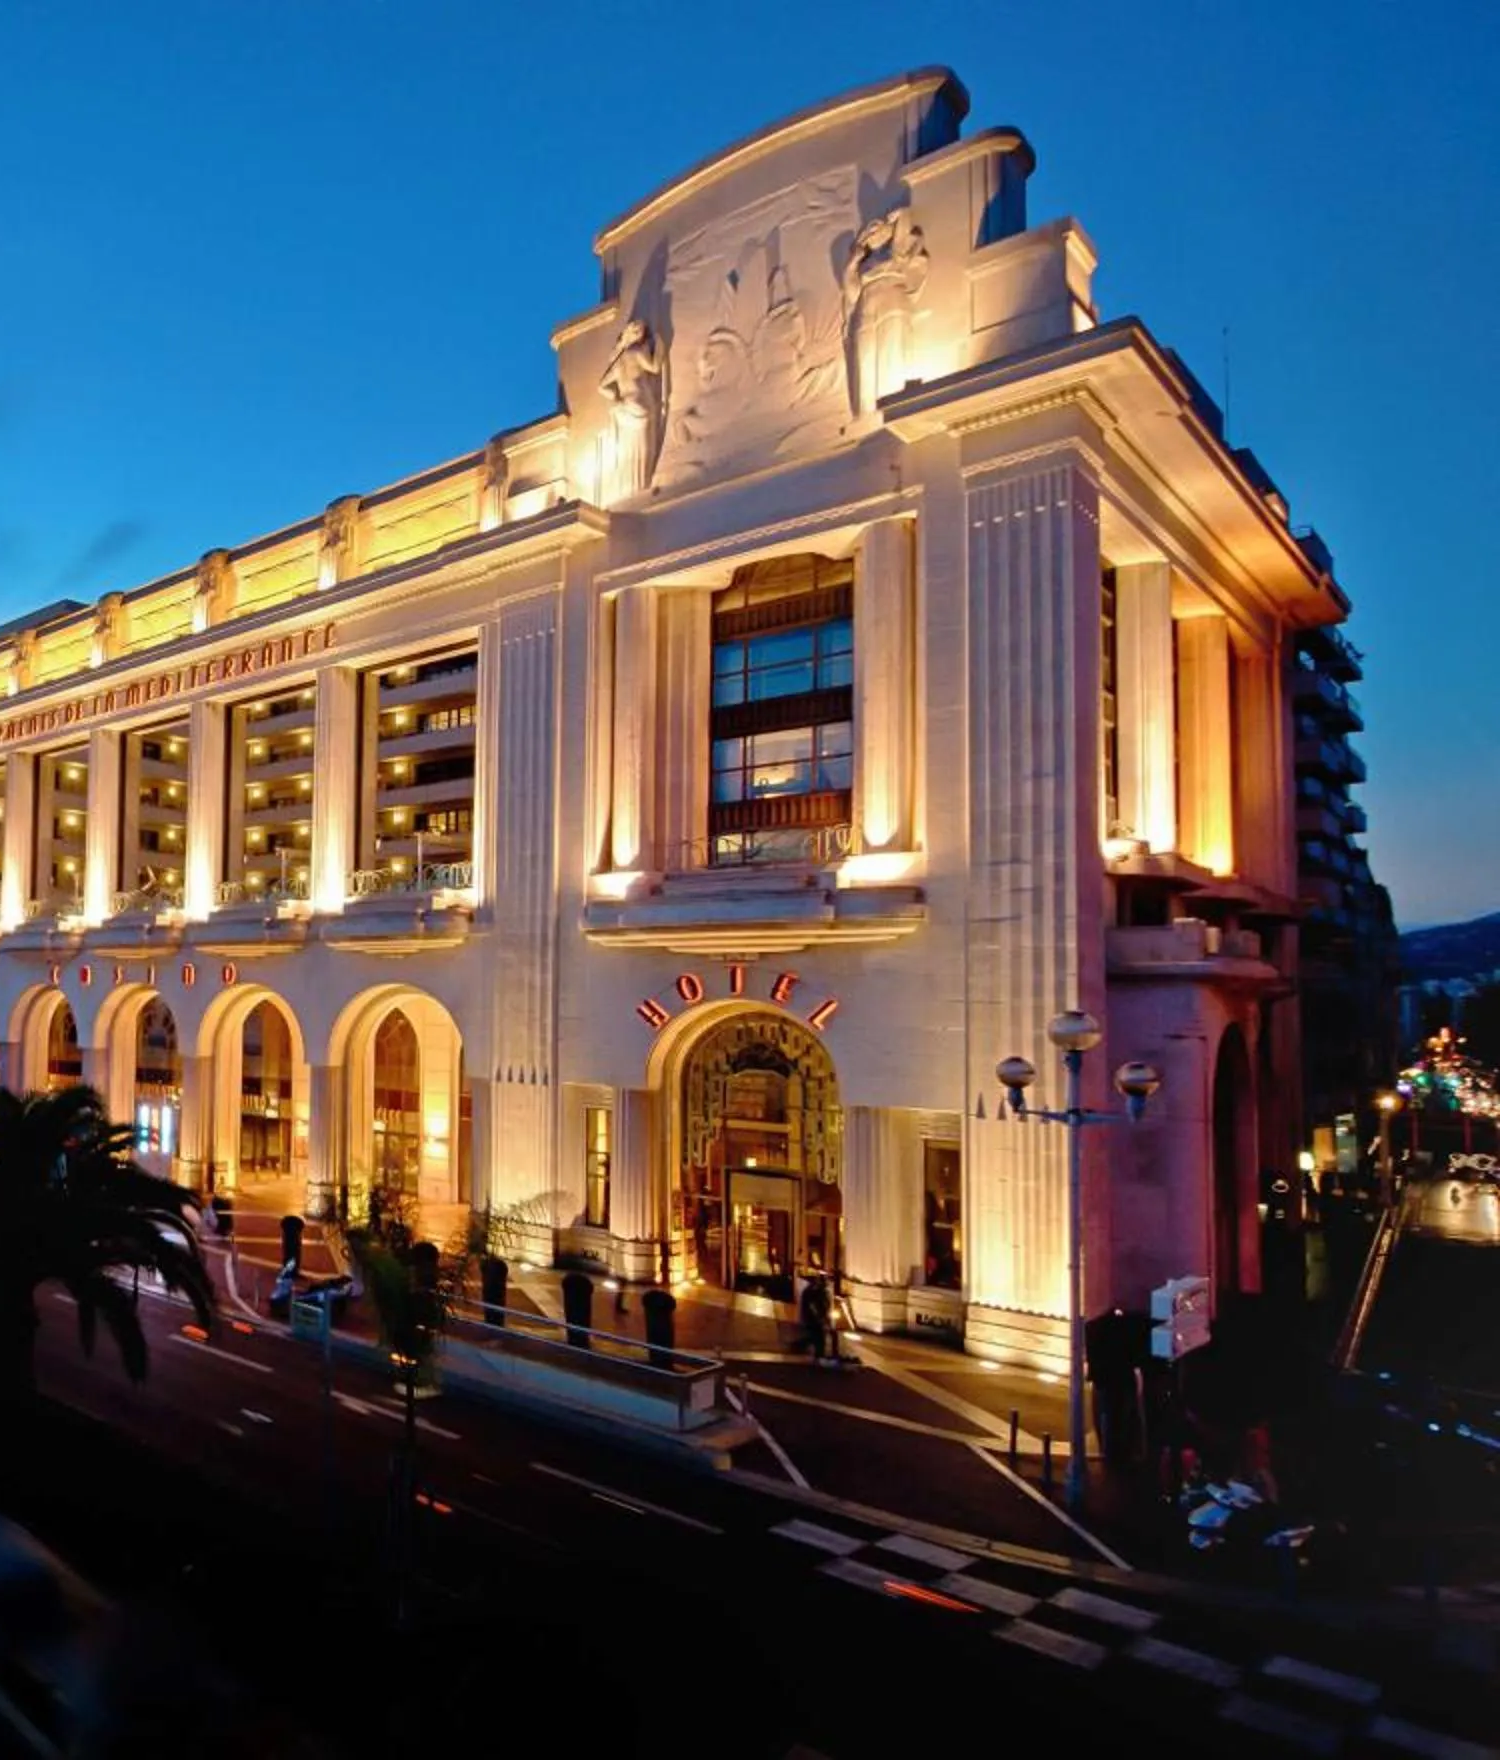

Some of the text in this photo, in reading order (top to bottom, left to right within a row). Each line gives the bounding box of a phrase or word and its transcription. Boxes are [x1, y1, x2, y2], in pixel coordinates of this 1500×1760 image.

[65, 701, 84, 723] DE
[93, 691, 117, 715] LA
[125, 622, 336, 706] MEDITERRANEE
[51, 962, 236, 988] CASINO
[636, 963, 839, 1029] HOTEL
